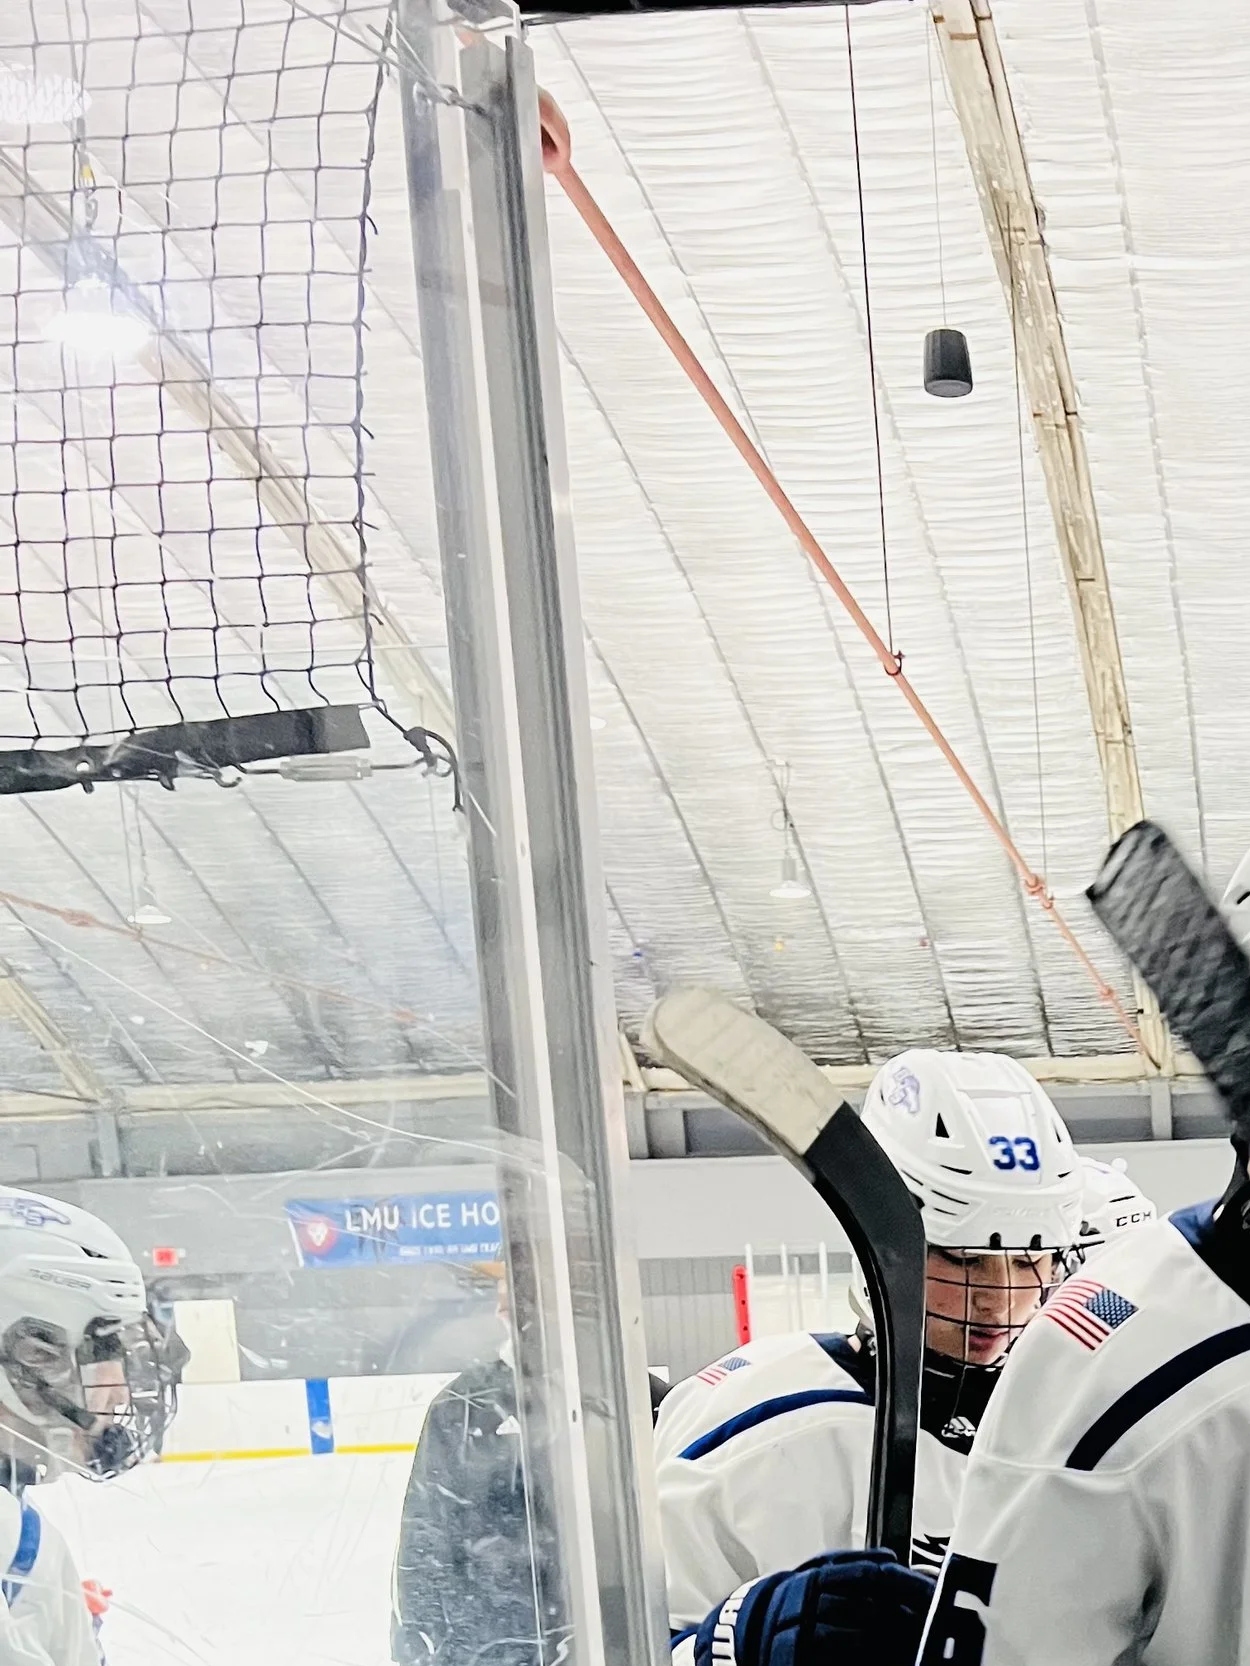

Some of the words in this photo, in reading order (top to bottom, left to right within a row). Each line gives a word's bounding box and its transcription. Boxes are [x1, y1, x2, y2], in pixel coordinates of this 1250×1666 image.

[988, 1136, 1041, 1171] 33
[344, 1205, 399, 1232] LMU
[411, 1203, 451, 1229] ICE
